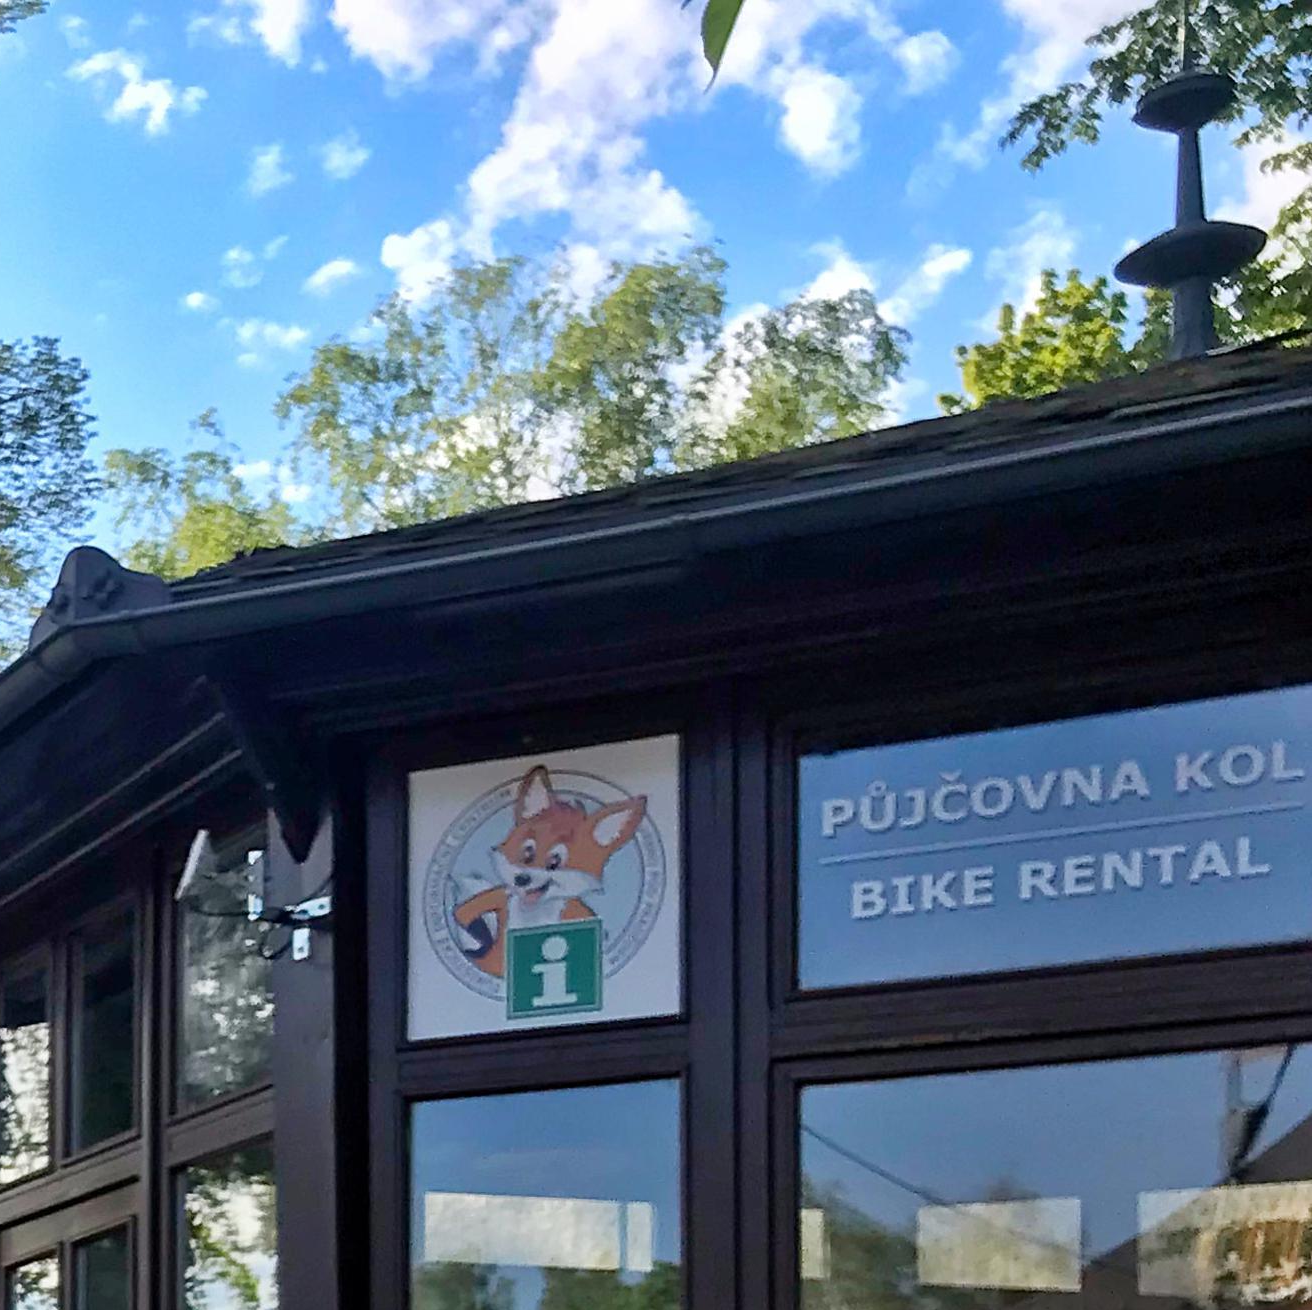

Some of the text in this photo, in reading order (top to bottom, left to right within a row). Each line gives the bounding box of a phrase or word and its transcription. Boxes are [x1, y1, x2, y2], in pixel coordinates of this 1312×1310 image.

[822, 740, 1305, 837] PŮJČOVNA KOL
[851, 837, 1271, 920] BIKE RENTAL
